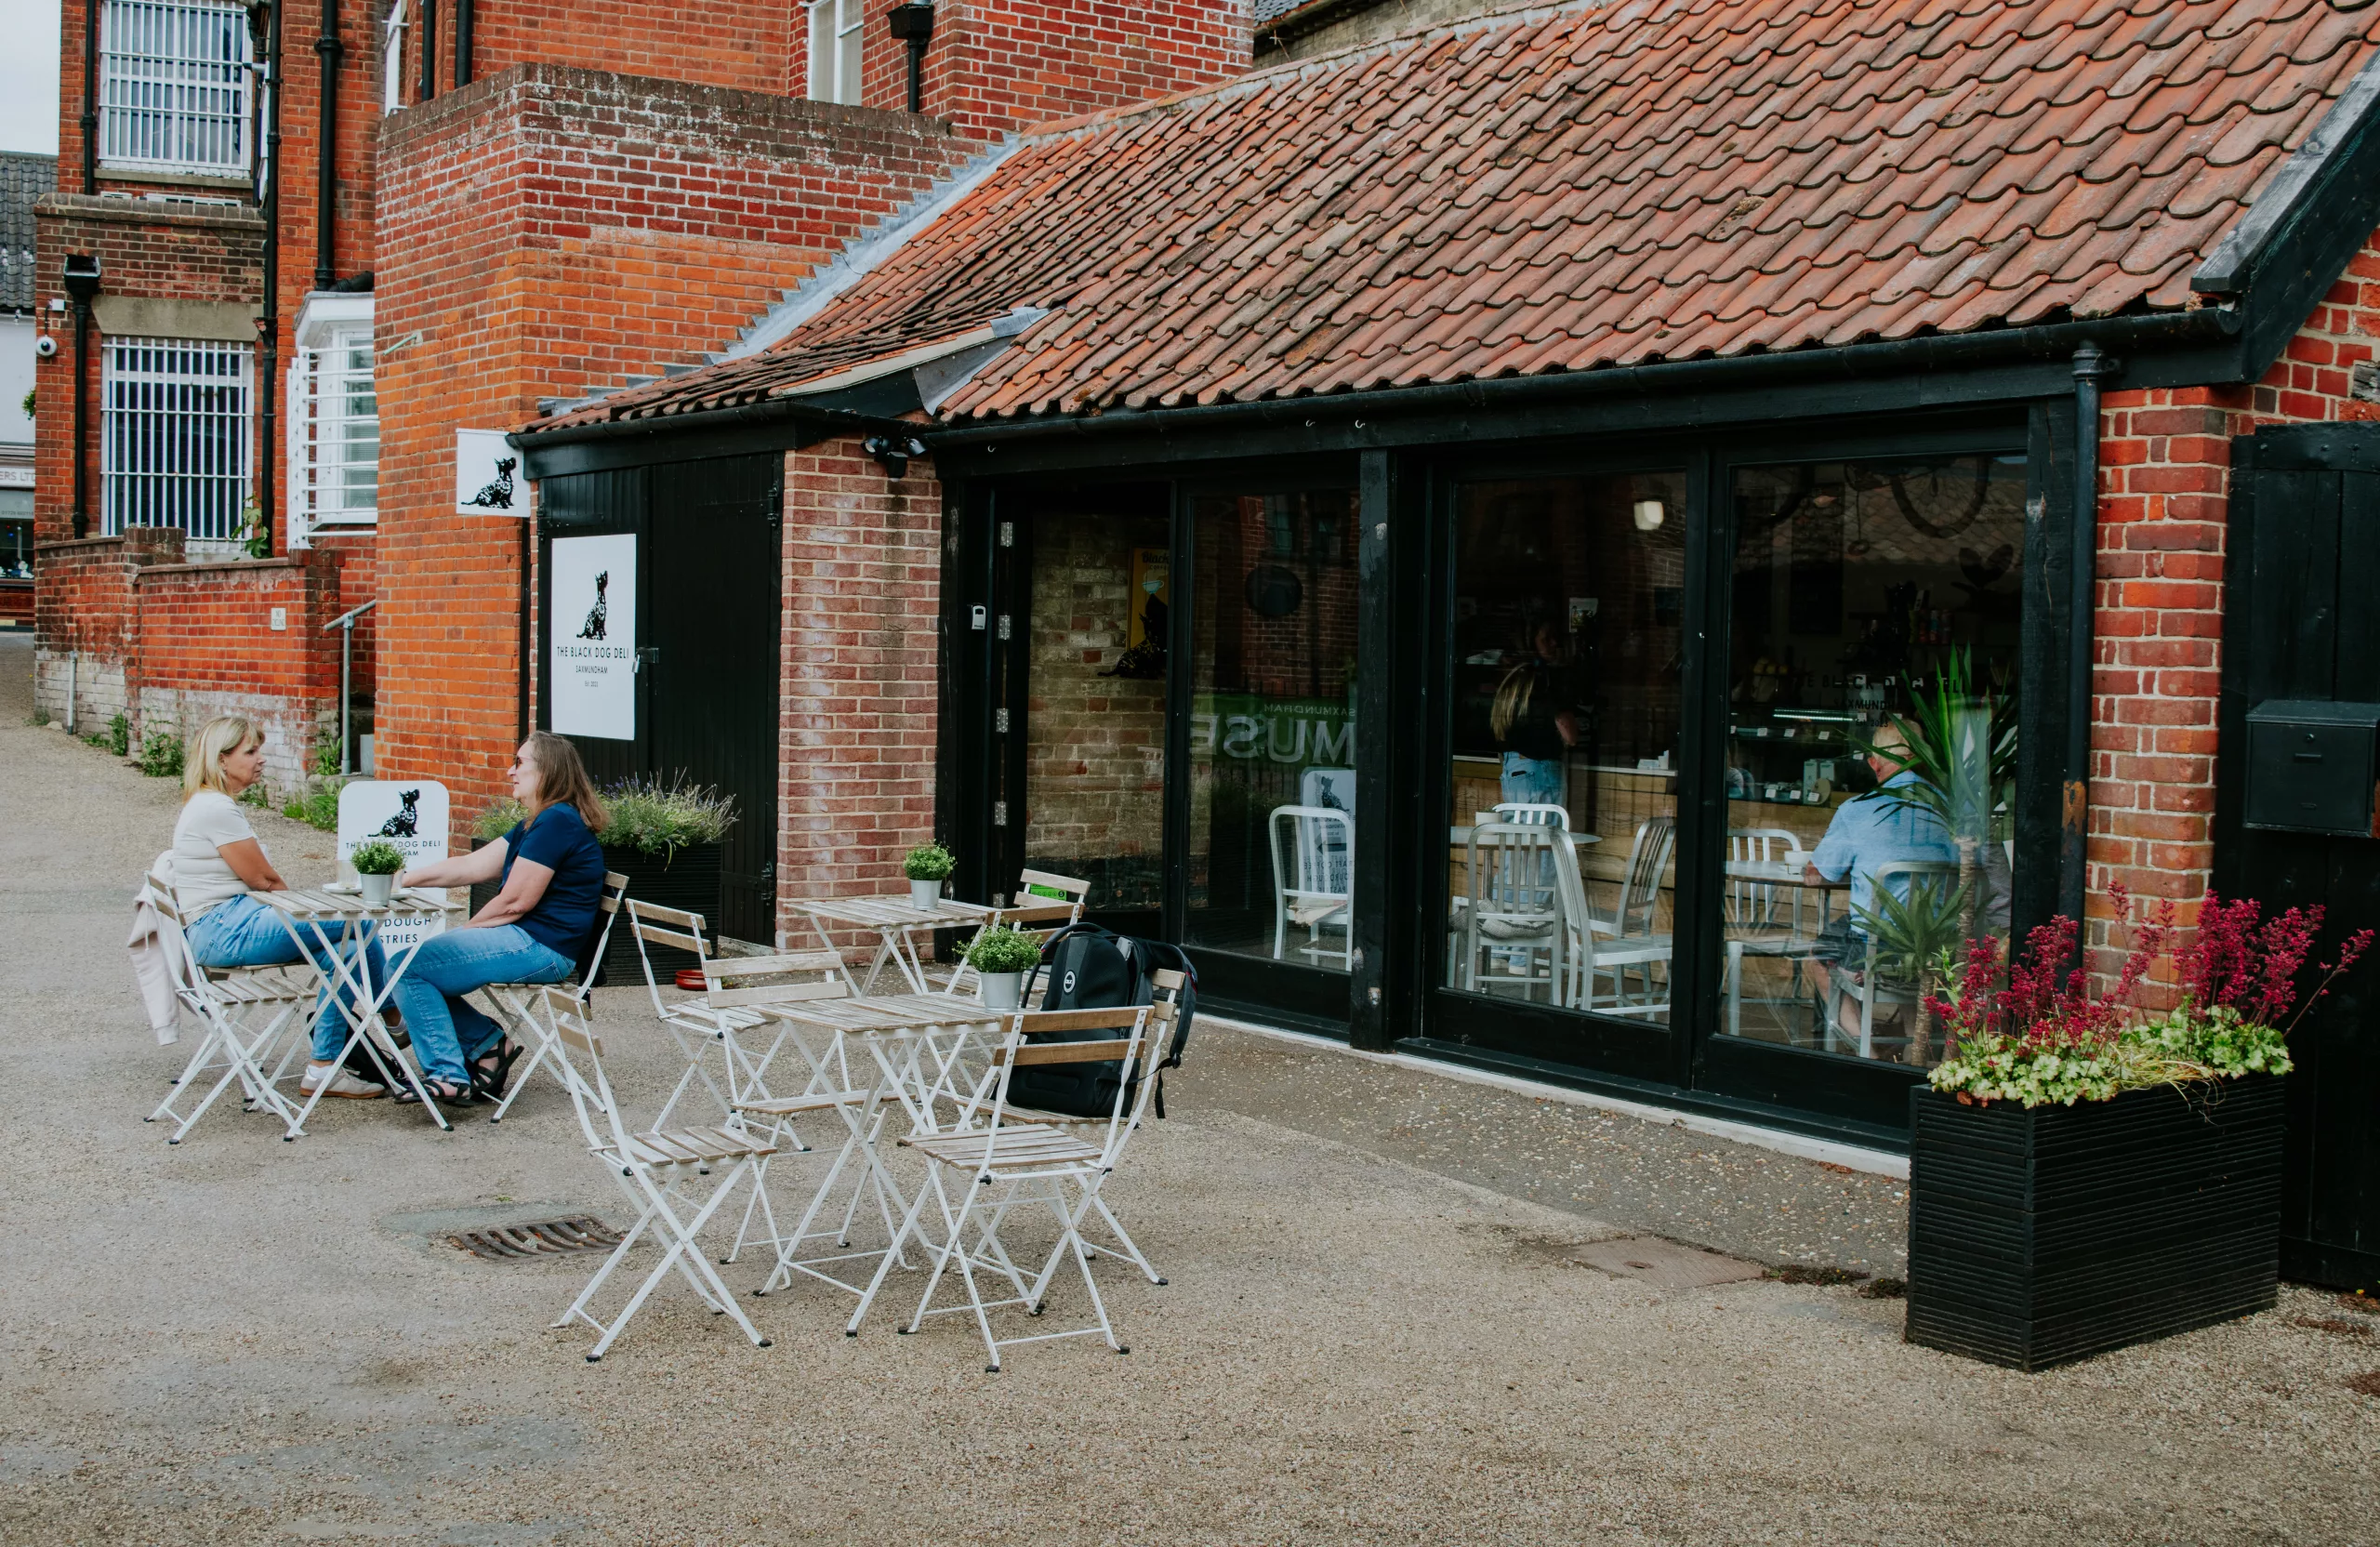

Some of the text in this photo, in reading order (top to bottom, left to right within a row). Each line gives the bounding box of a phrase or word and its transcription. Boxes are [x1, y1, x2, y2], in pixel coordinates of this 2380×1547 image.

[557, 646, 629, 658] THE BLACK DOG DELI
[384, 918, 431, 927] DOUGH
[380, 933, 418, 944] STRIES
